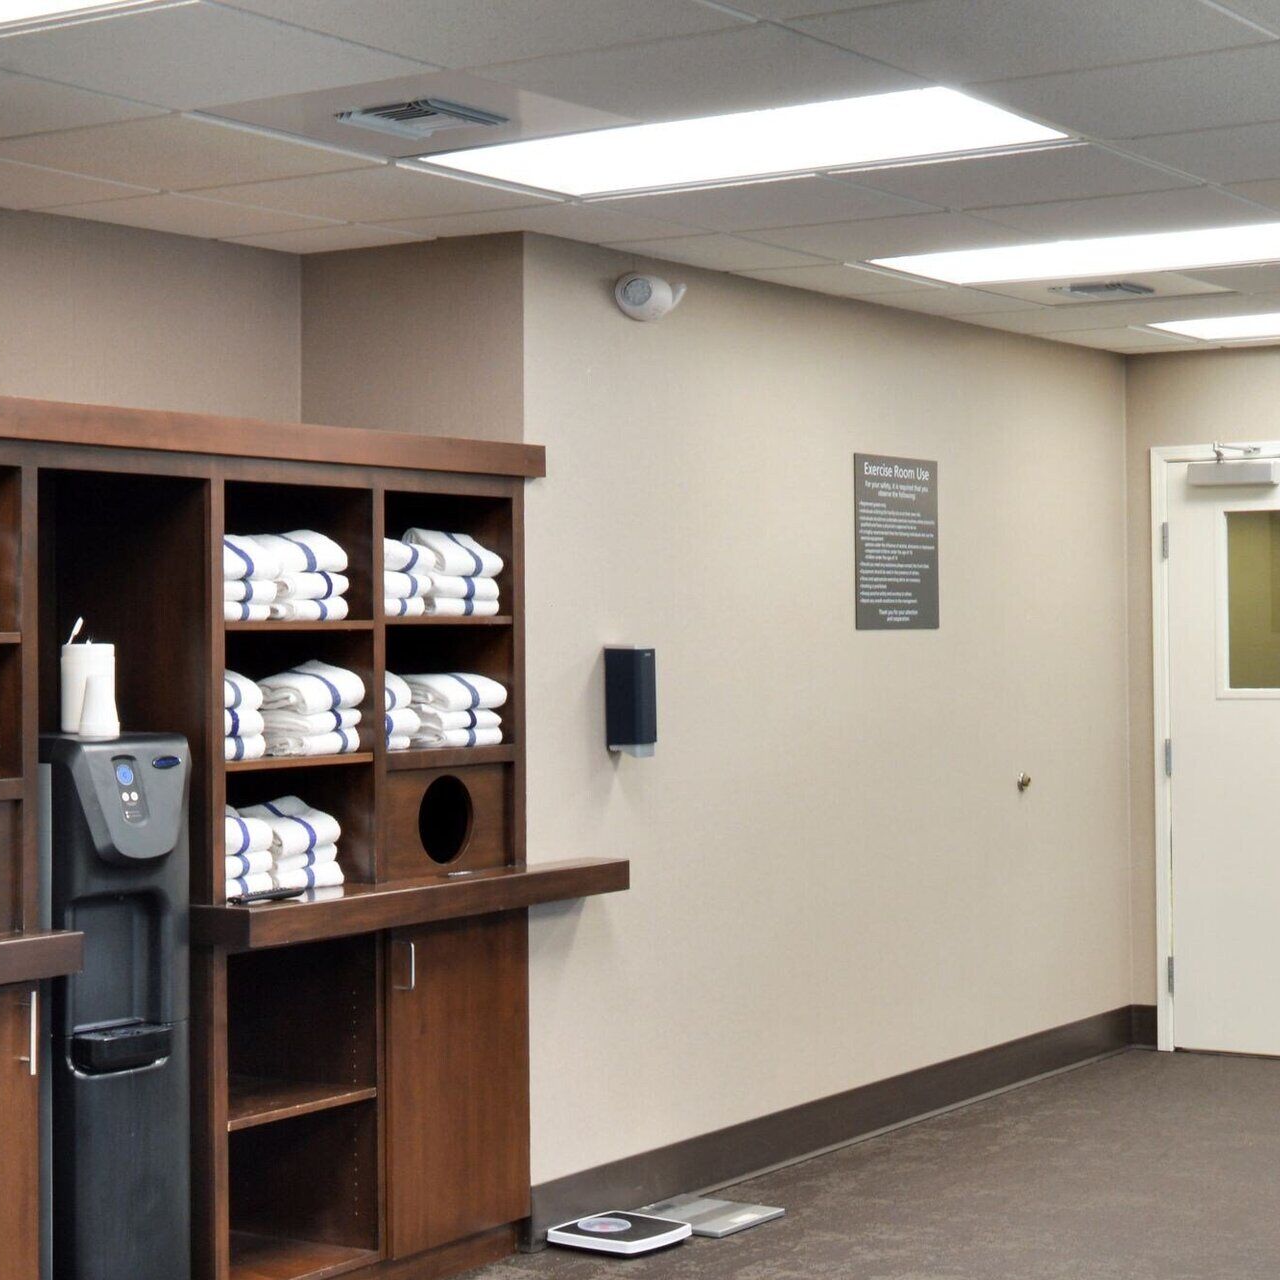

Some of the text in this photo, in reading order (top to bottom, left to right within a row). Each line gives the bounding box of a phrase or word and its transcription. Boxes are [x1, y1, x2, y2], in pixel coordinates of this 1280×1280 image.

[864, 461, 930, 481] Exercise Room Use
